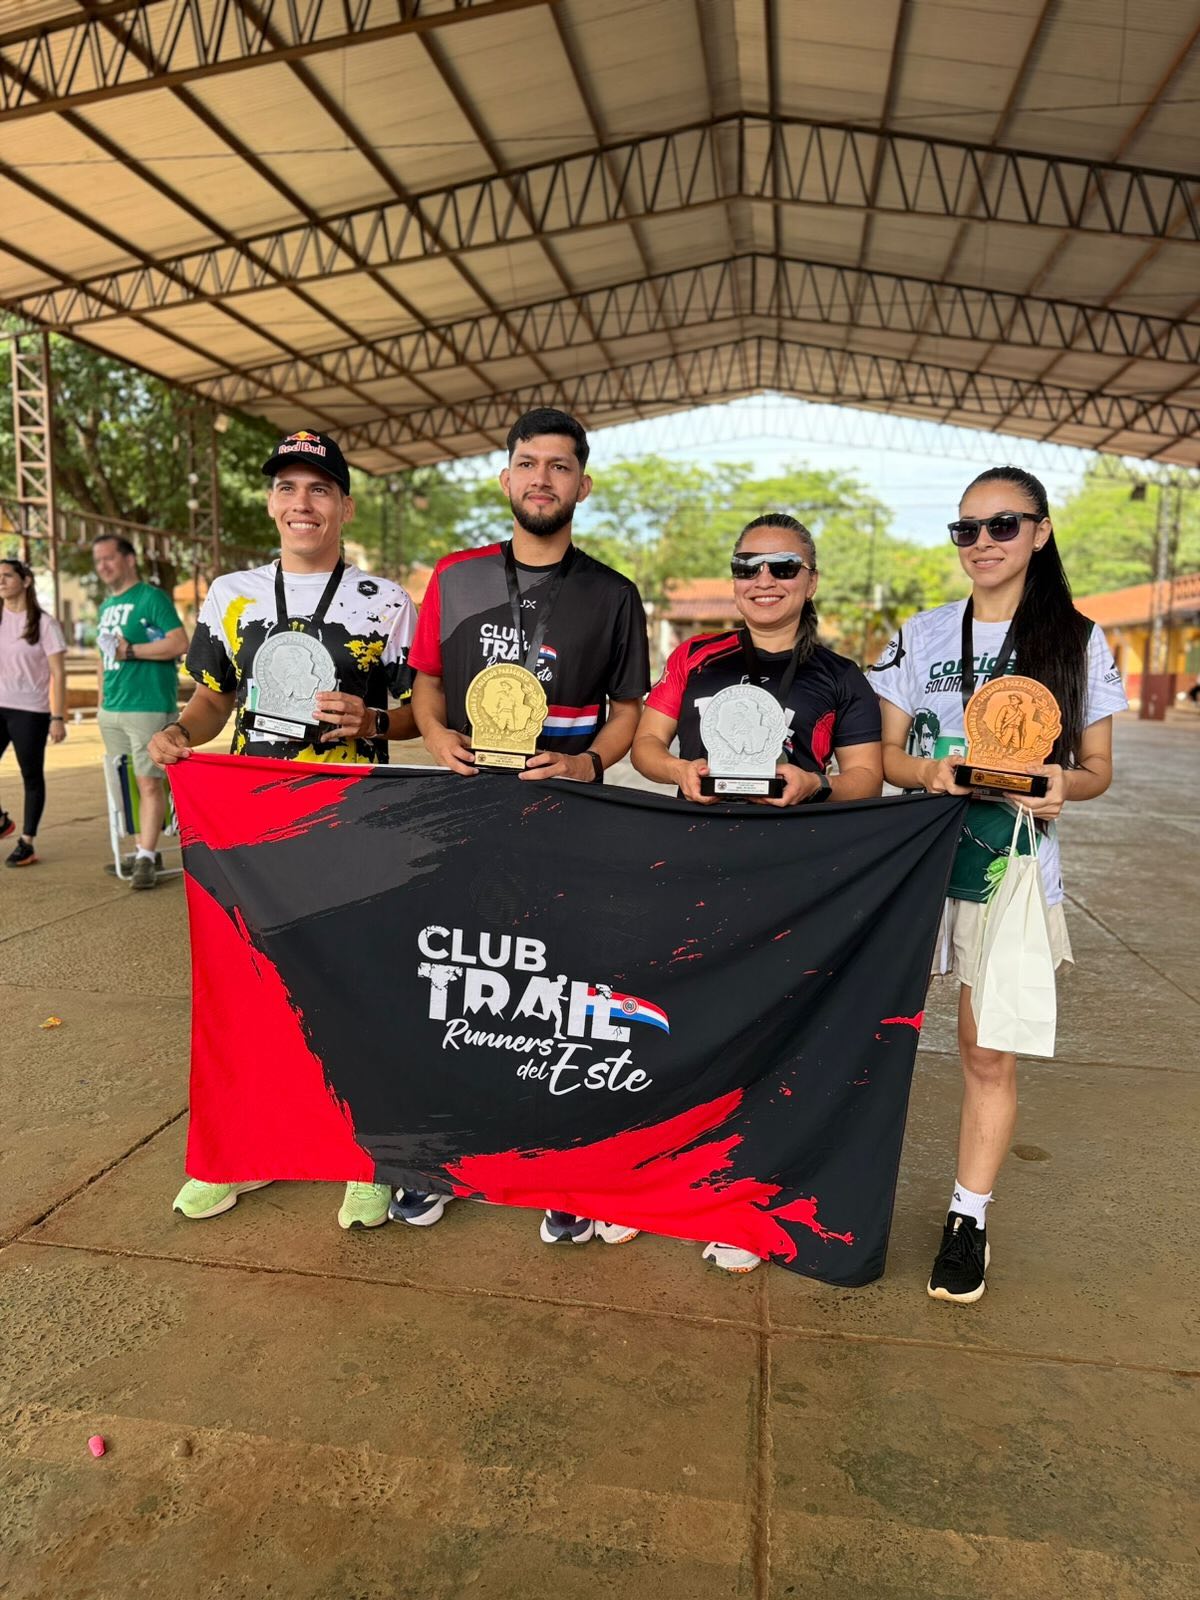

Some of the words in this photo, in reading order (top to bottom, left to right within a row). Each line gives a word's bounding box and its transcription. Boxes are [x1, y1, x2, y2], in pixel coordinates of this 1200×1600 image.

[278, 441, 300, 454] Red
[301, 442, 327, 457] Bull
[925, 674, 980, 694] SOLDAO
[930, 653, 1017, 680] Coida
[417, 925, 547, 972] CLUB
[417, 962, 631, 1042] TRAIL
[442, 1018, 554, 1056] Runners
[516, 1058, 549, 1081] del
[549, 1042, 652, 1096] Este
